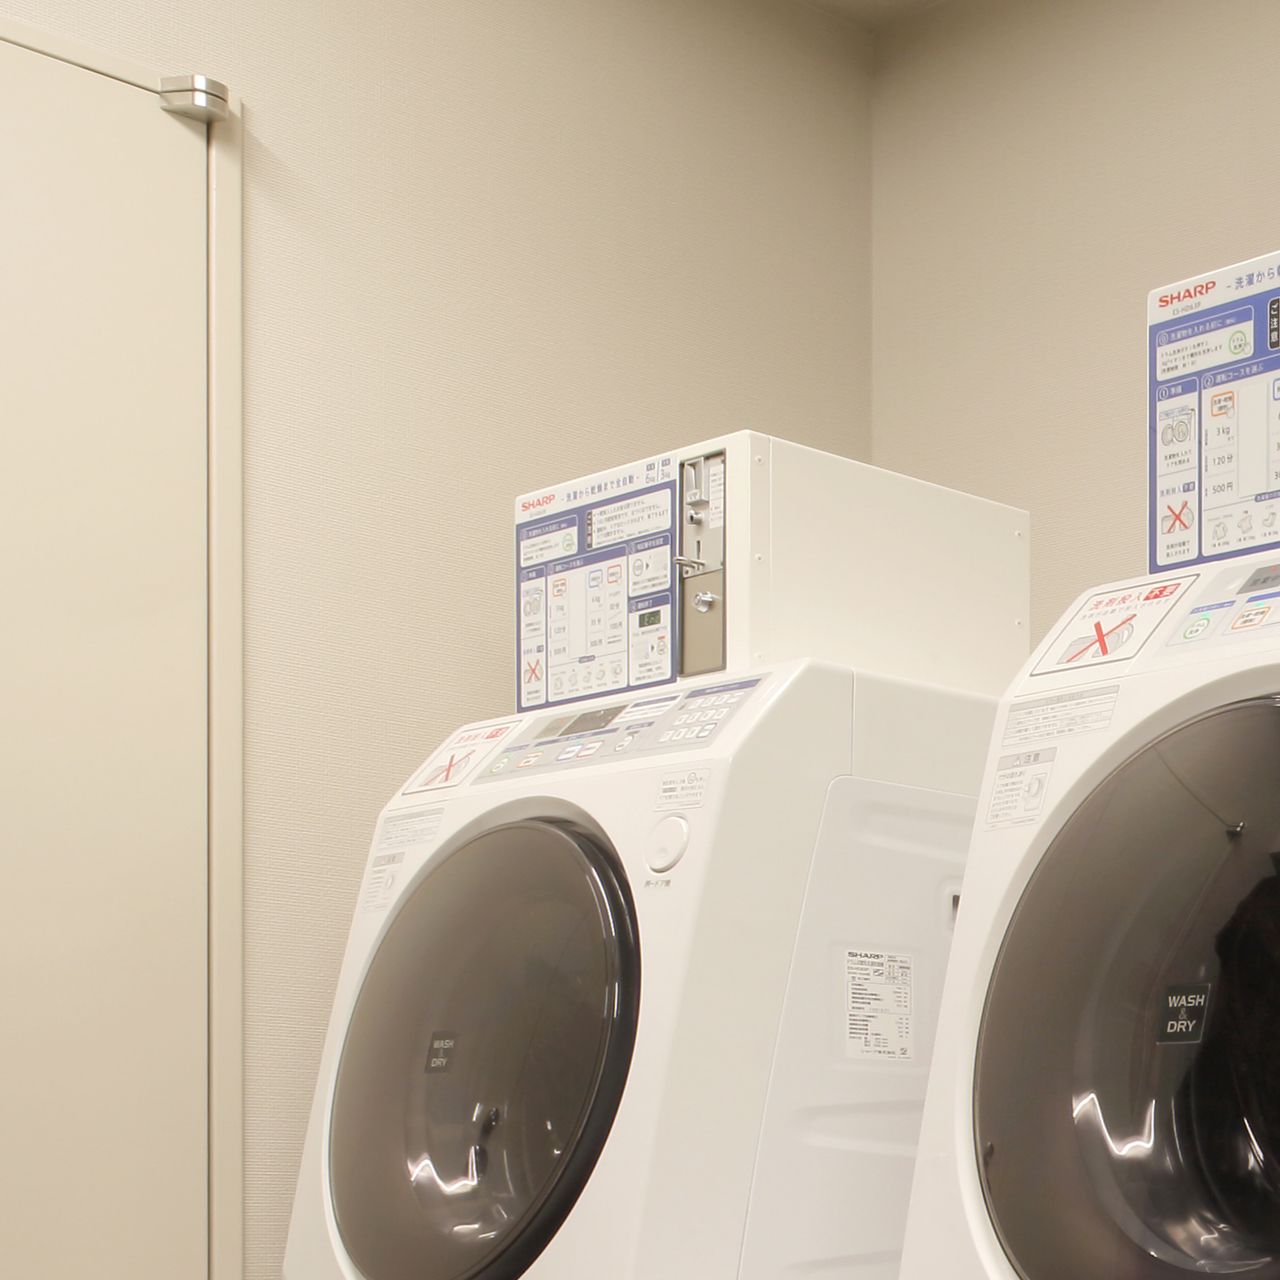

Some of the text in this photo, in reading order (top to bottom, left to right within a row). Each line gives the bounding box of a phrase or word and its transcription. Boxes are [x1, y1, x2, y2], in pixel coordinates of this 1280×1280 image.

[1158, 280, 1216, 308] SHARP
[521, 494, 555, 512] SHARP
[1168, 994, 1205, 1007] WASH
[1167, 1020, 1196, 1032] DRY
